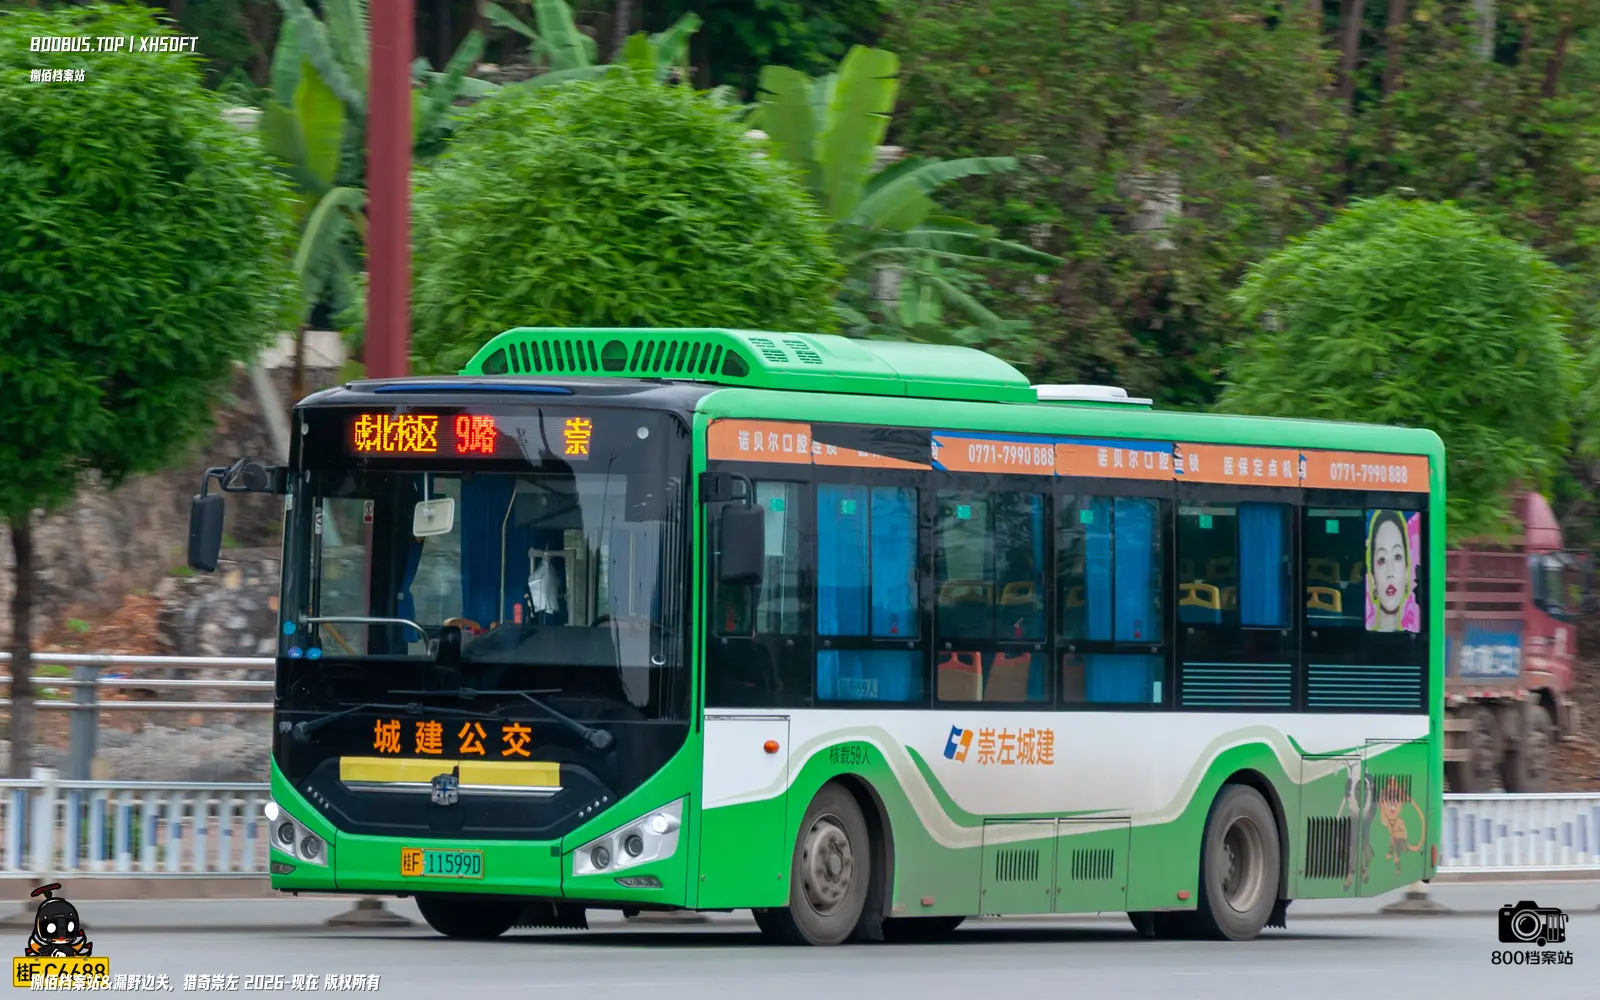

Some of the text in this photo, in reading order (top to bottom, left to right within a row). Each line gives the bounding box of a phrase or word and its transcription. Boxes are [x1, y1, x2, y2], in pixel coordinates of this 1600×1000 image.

[456, 416, 497, 453] 9路
[373, 719, 532, 757] 城建公交
[829, 745, 872, 765] 核载59人
[977, 727, 1055, 766] 崇左城建
